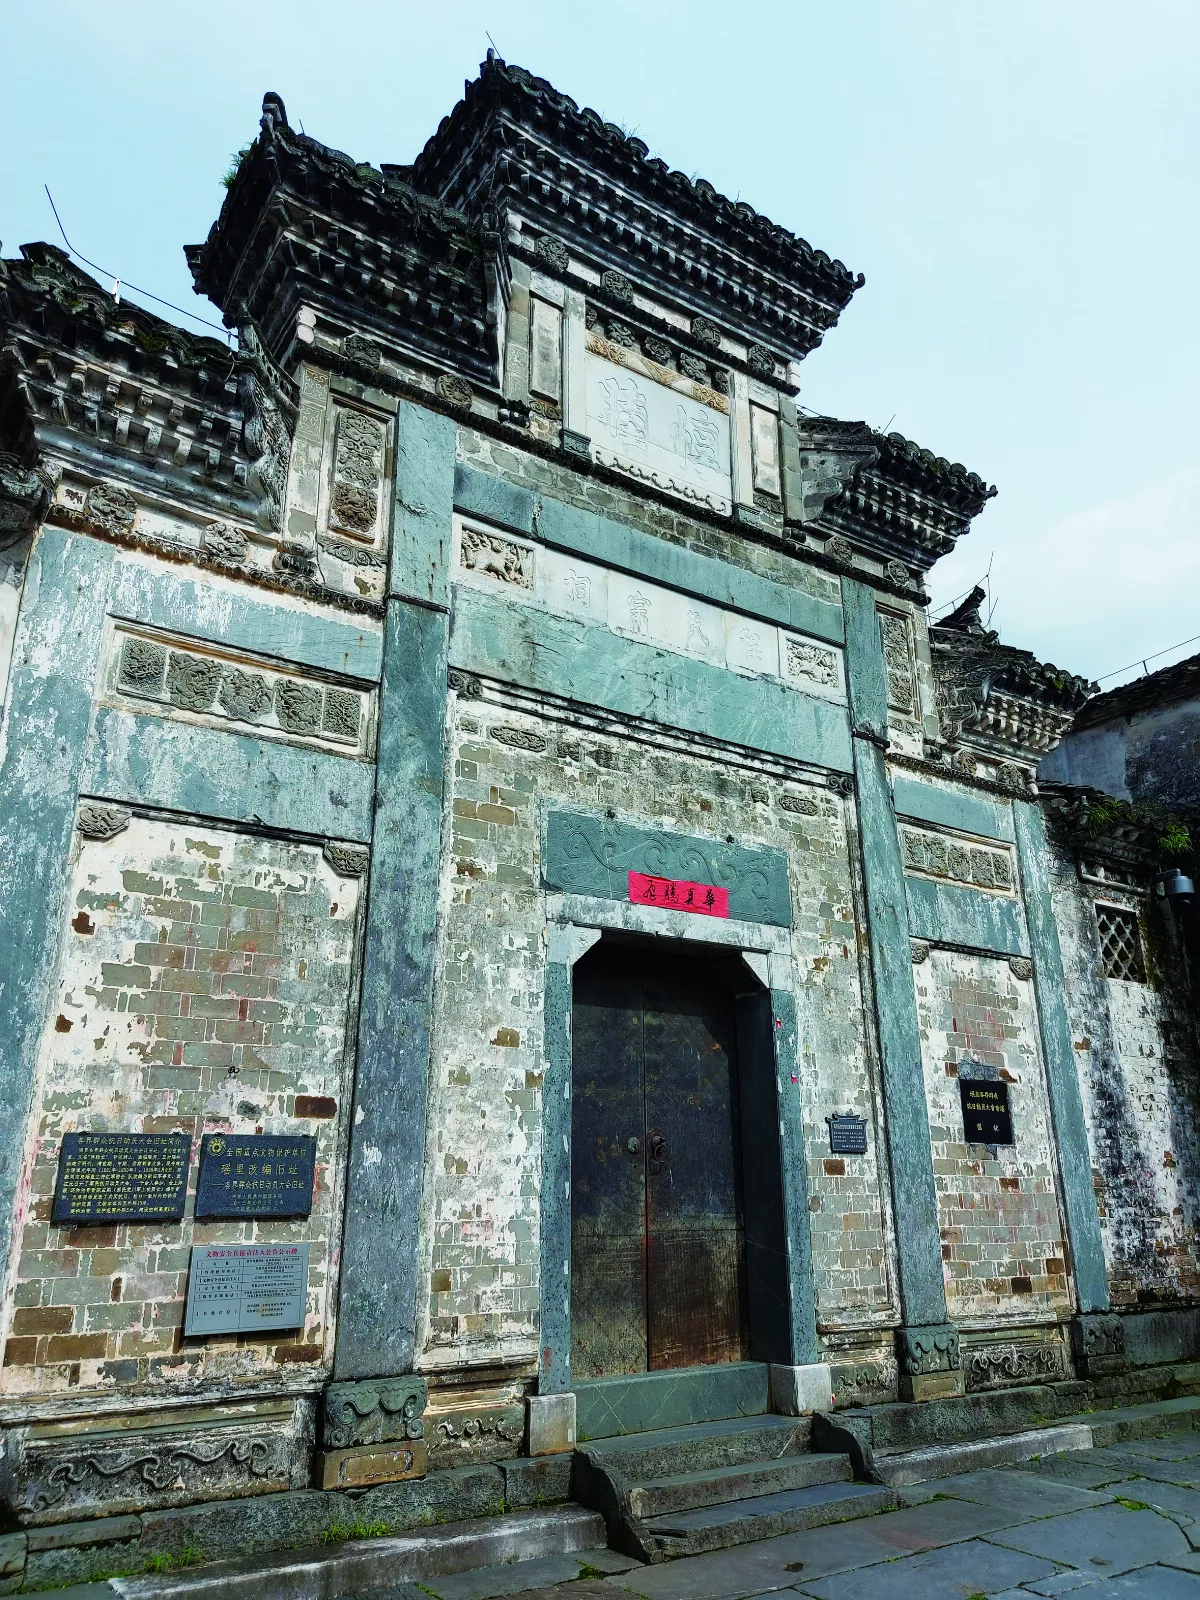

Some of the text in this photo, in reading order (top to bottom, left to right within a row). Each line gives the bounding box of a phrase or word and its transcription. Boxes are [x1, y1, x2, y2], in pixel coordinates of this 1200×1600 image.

[220, 1163, 299, 1176] 瑶里改编旧址
